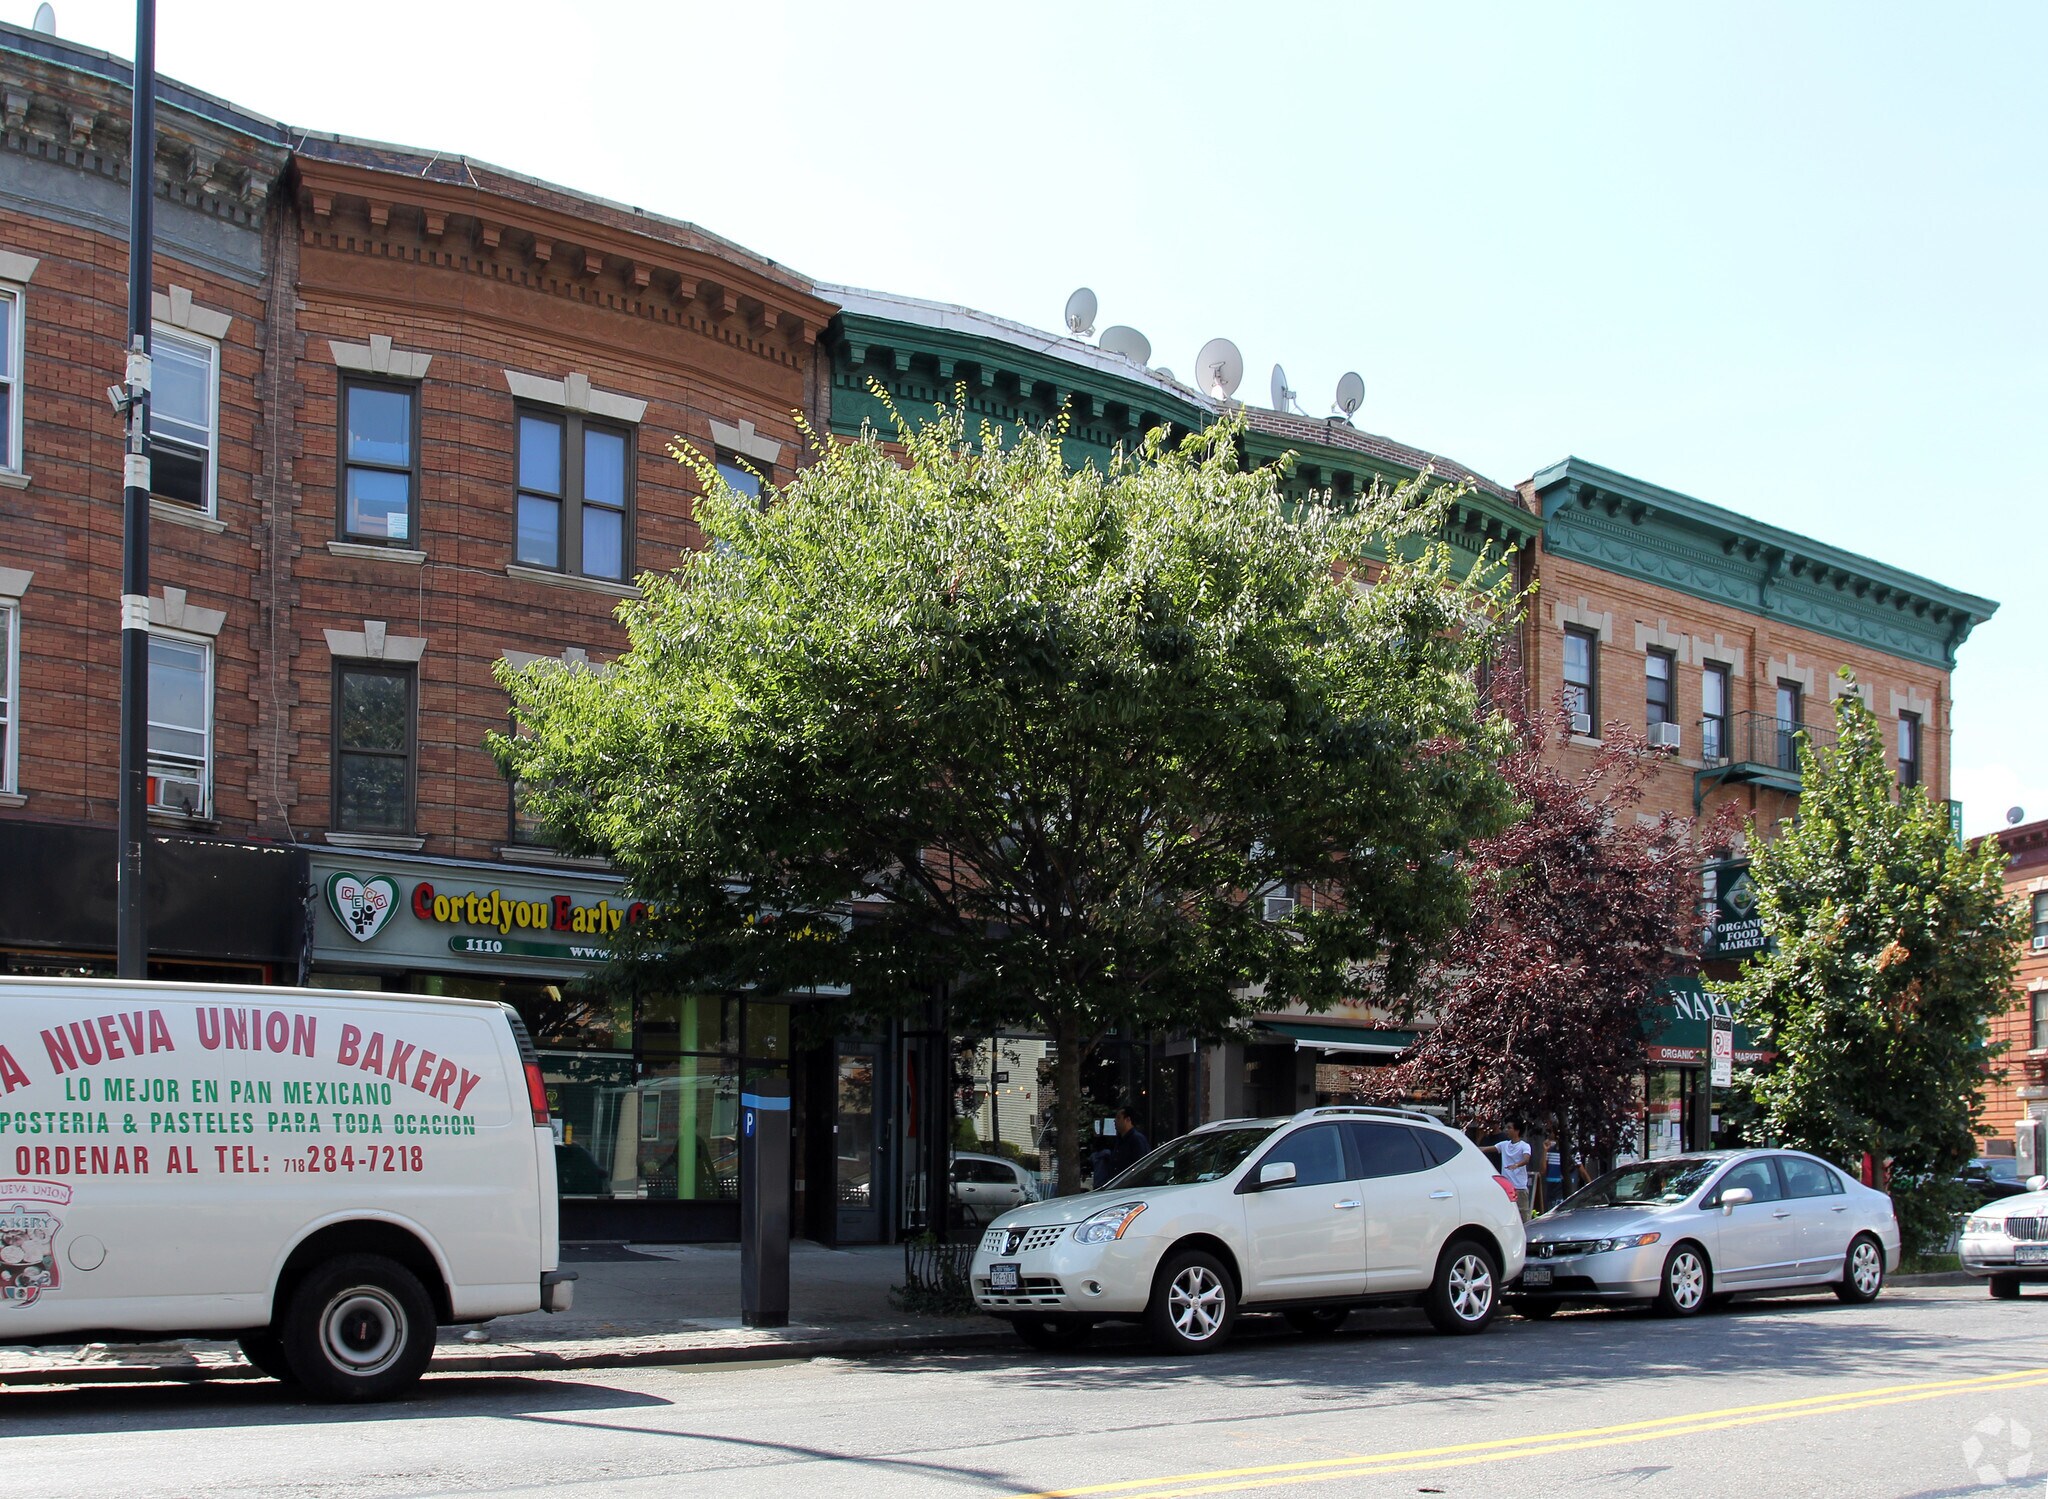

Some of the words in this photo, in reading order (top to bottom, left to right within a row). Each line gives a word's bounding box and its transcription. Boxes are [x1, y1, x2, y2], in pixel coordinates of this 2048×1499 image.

[412, 882, 548, 935] Cortelyou
[466, 938, 502, 952] 1110
[1720, 936, 1766, 951] MARKET
[1726, 928, 1758, 941] FOOD
[0, 1044, 31, 1098] A
[40, 1009, 175, 1075] NUEVA
[195, 1007, 317, 1058] UNION
[337, 1023, 481, 1111] BAKERY
[1661, 1048, 1694, 1059] ORGANIC
[65, 1077, 91, 1102] LO
[104, 1077, 180, 1103] MEJOR
[192, 1079, 218, 1103] EN
[231, 1080, 271, 1104] PAN
[283, 1081, 392, 1106] MEXICANO
[0, 1111, 110, 1134] POSTERIA
[123, 1113, 138, 1133] &
[150, 1112, 254, 1134] PASTELES
[267, 1111, 321, 1133] PARA
[332, 1113, 383, 1134] TODA
[394, 1114, 476, 1135] OCACION
[746, 1112, 753, 1134] P
[15, 1145, 149, 1176] ORDENAR
[166, 1145, 199, 1174] AL
[214, 1145, 269, 1173] TEL:
[33, 1185, 67, 1199] UNION
